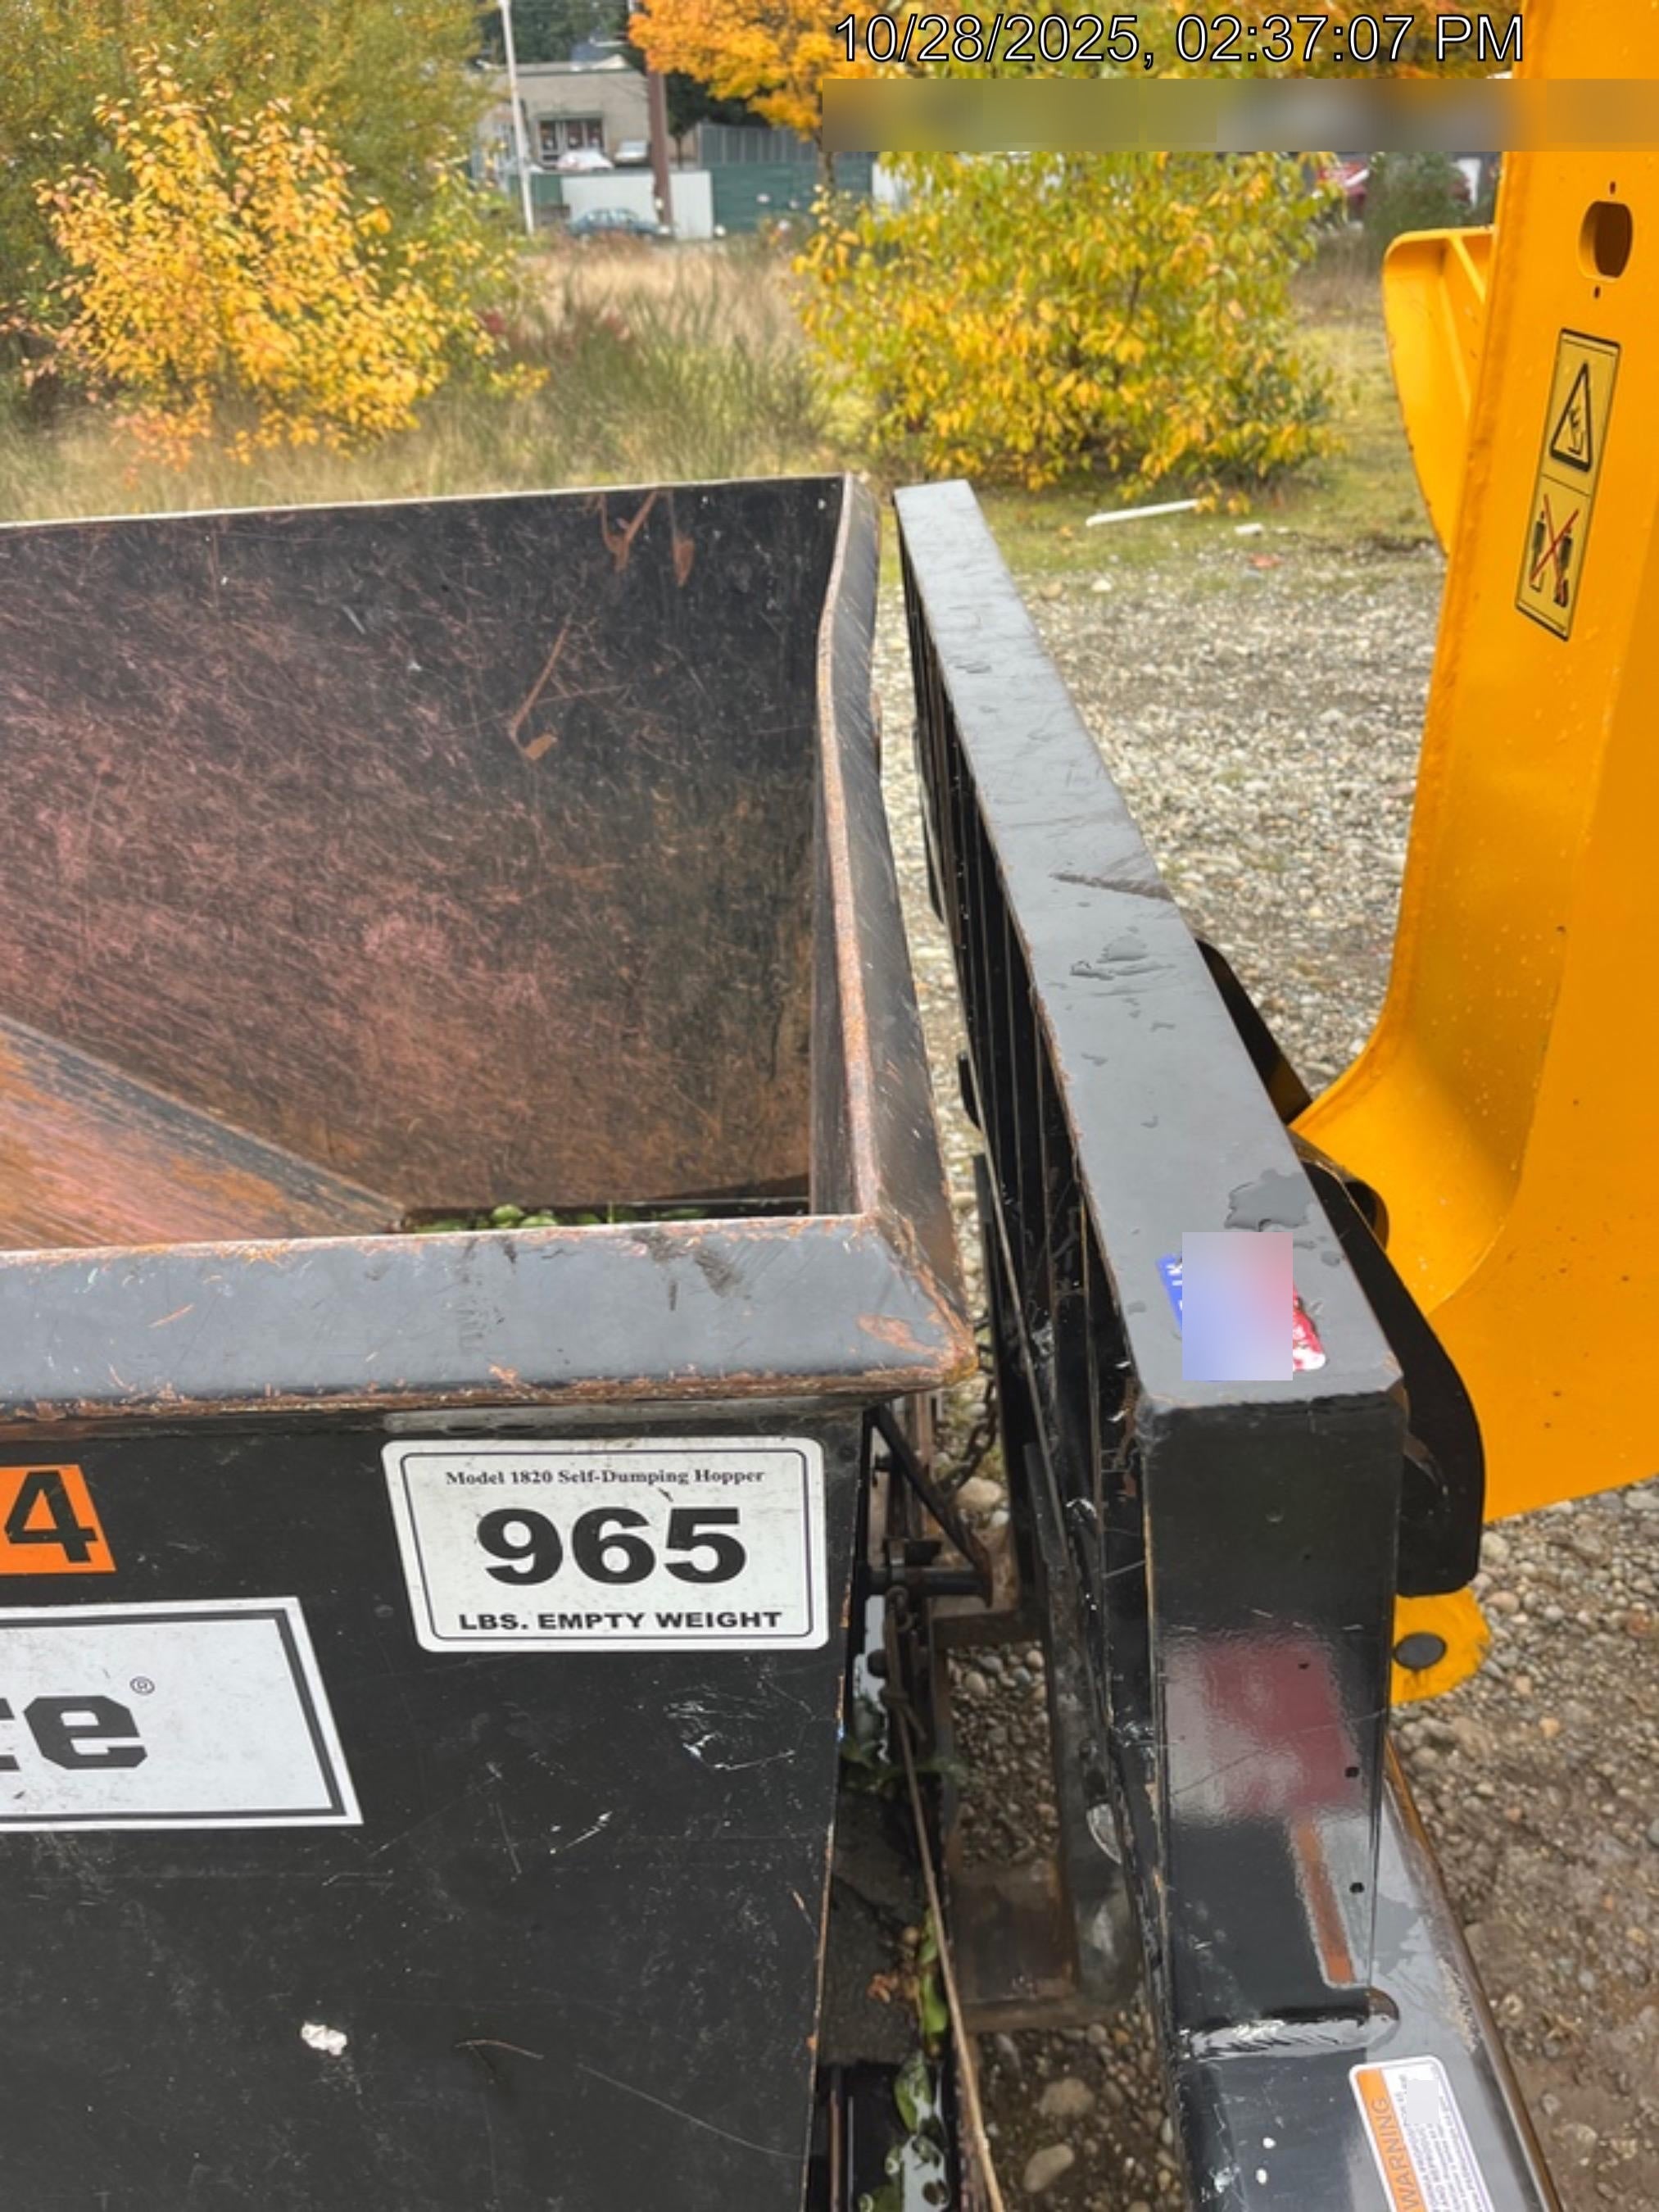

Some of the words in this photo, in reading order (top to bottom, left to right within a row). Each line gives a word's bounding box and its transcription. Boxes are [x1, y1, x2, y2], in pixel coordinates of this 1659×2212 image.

[446, 1471, 505, 1485] Model
[511, 1471, 553, 1484] 1820
[559, 1469, 689, 1486] Self-Dumping
[695, 1468, 764, 1485] Hopper
[4, 1471, 98, 1563] 4
[476, 1507, 747, 1586] 965
[459, 1613, 528, 1630] LBS.
[537, 1611, 646, 1630] EMPTY
[656, 1611, 782, 1629] WEIGHT
[1371, 2097, 1420, 2211] WARNING
